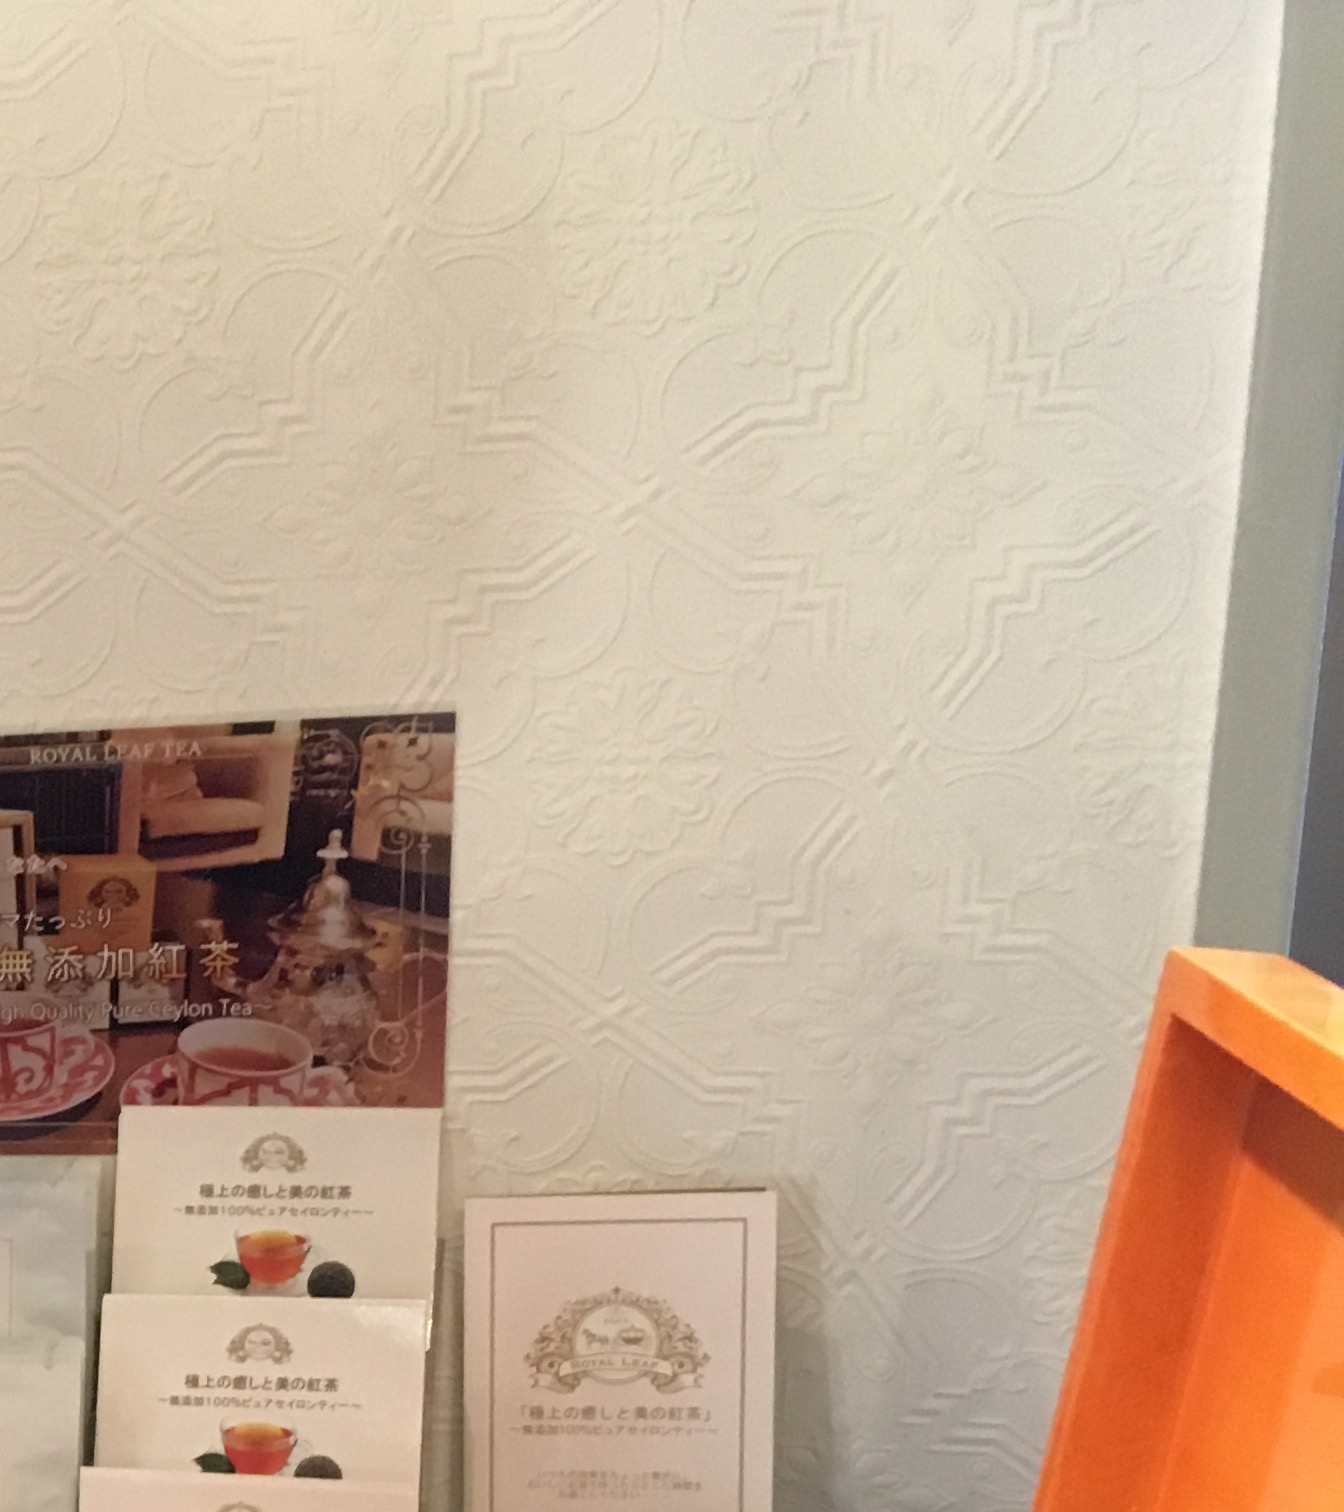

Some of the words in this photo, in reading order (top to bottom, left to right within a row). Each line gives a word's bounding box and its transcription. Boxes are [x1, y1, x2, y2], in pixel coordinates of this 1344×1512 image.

[29, 746, 97, 765] ROYAL
[104, 743, 155, 761] LEAF
[162, 741, 203, 759] TEA
[30, 1003, 95, 1023] Quality
[101, 1002, 143, 1018] Pure
[149, 999, 212, 1023] Ceylon
[570, 1357, 614, 1368] ROYAL
